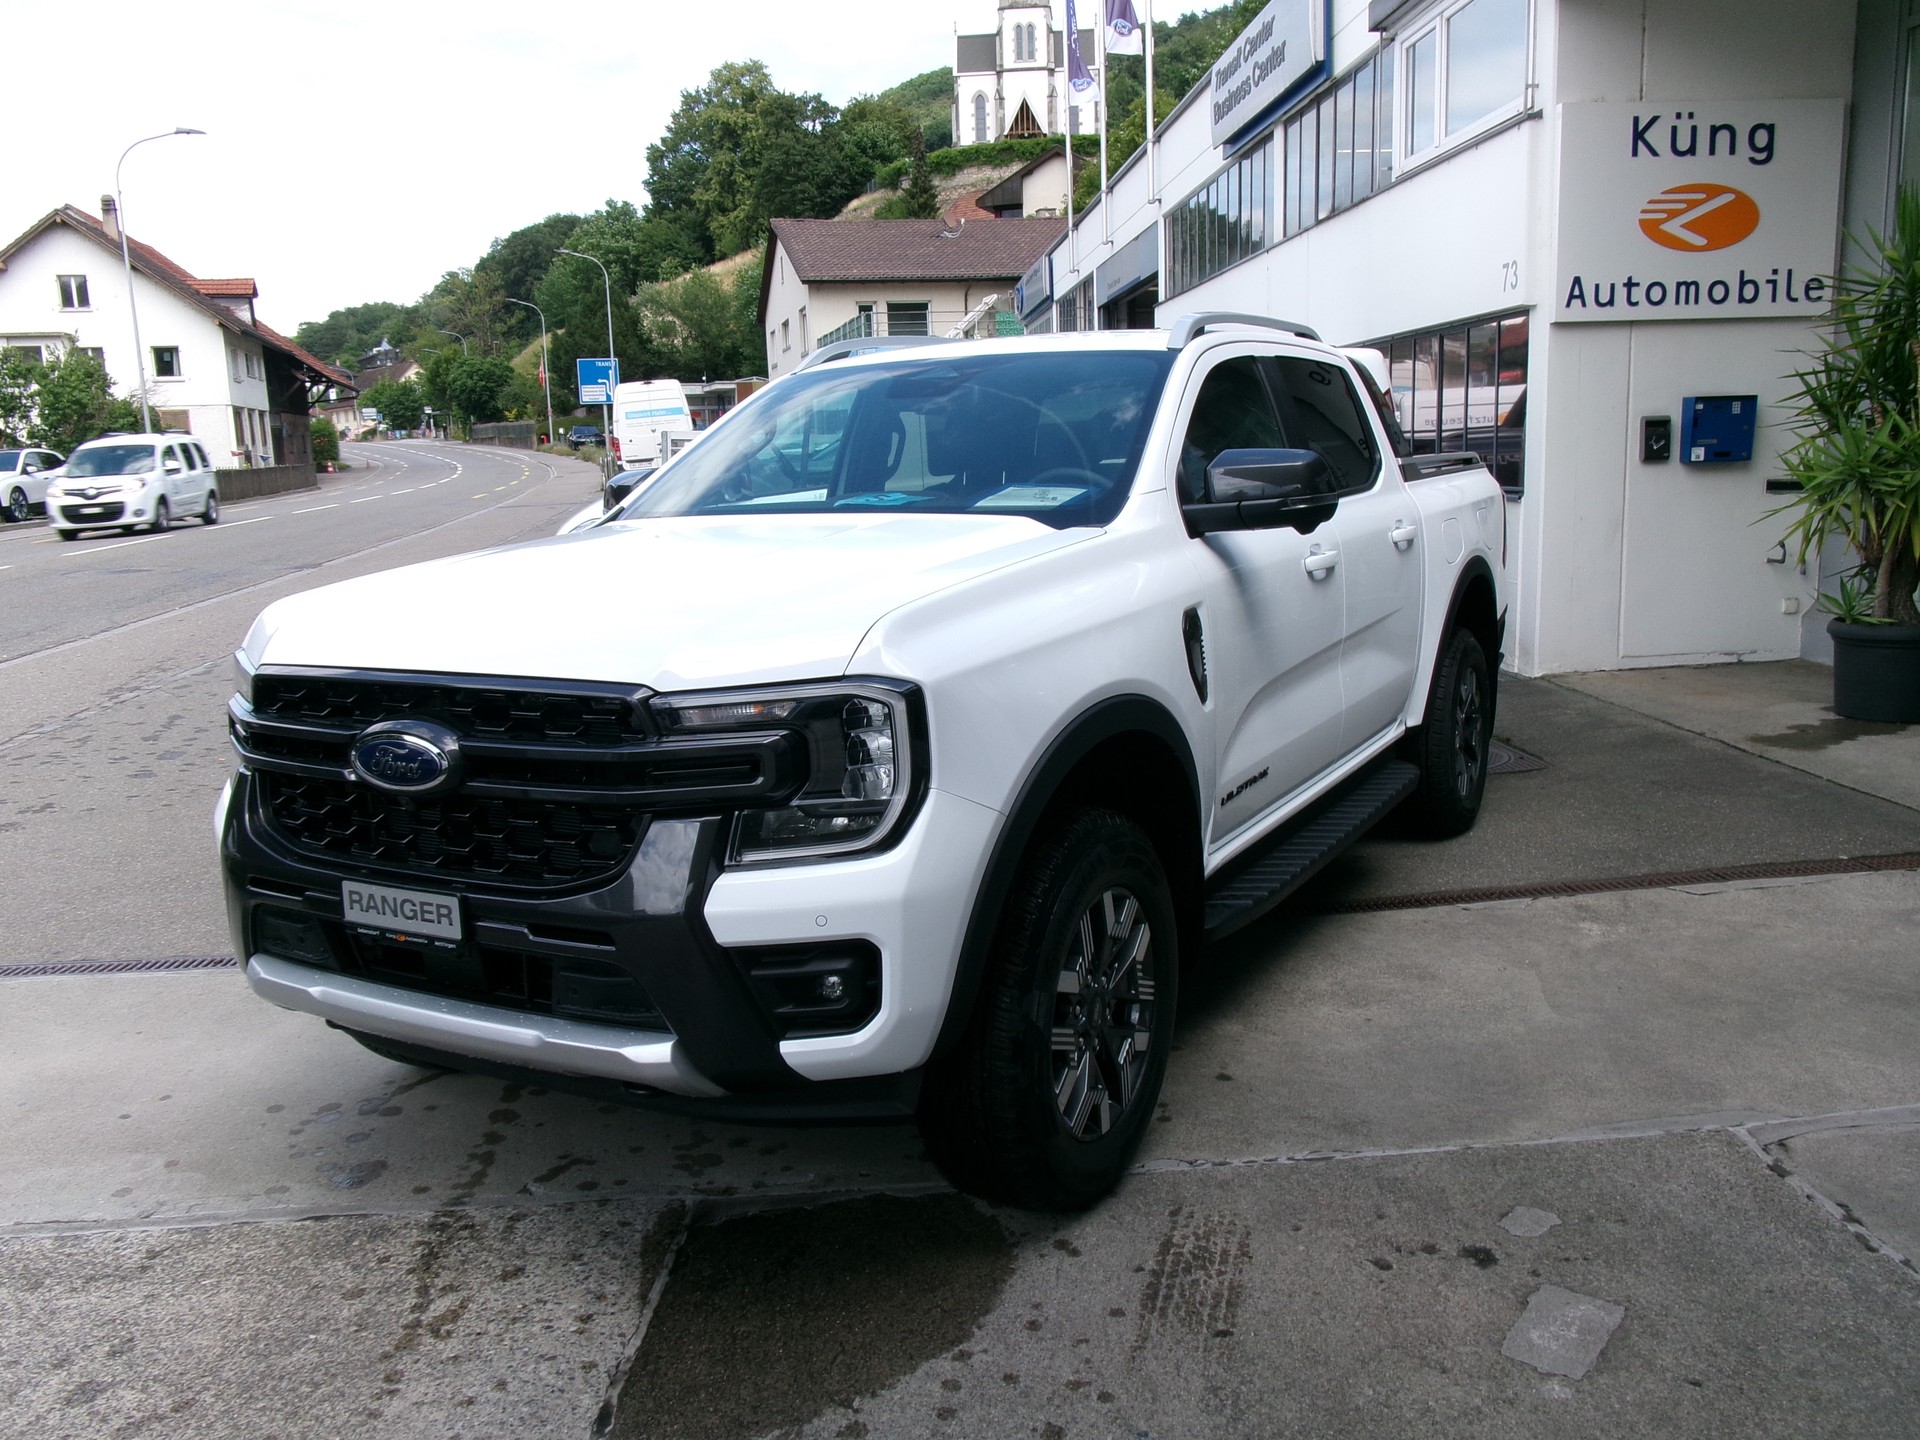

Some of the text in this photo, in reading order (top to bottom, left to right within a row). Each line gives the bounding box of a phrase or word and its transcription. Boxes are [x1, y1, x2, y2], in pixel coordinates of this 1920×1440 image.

[1215, 14, 1276, 93] Transit Center
[1213, 40, 1287, 126] Business Center
[1631, 111, 1776, 166] Küng
[1502, 260, 1519, 293] 73
[1565, 268, 1827, 309] Automobile
[370, 744, 423, 779] Ford
[347, 889, 454, 927] RANGER
